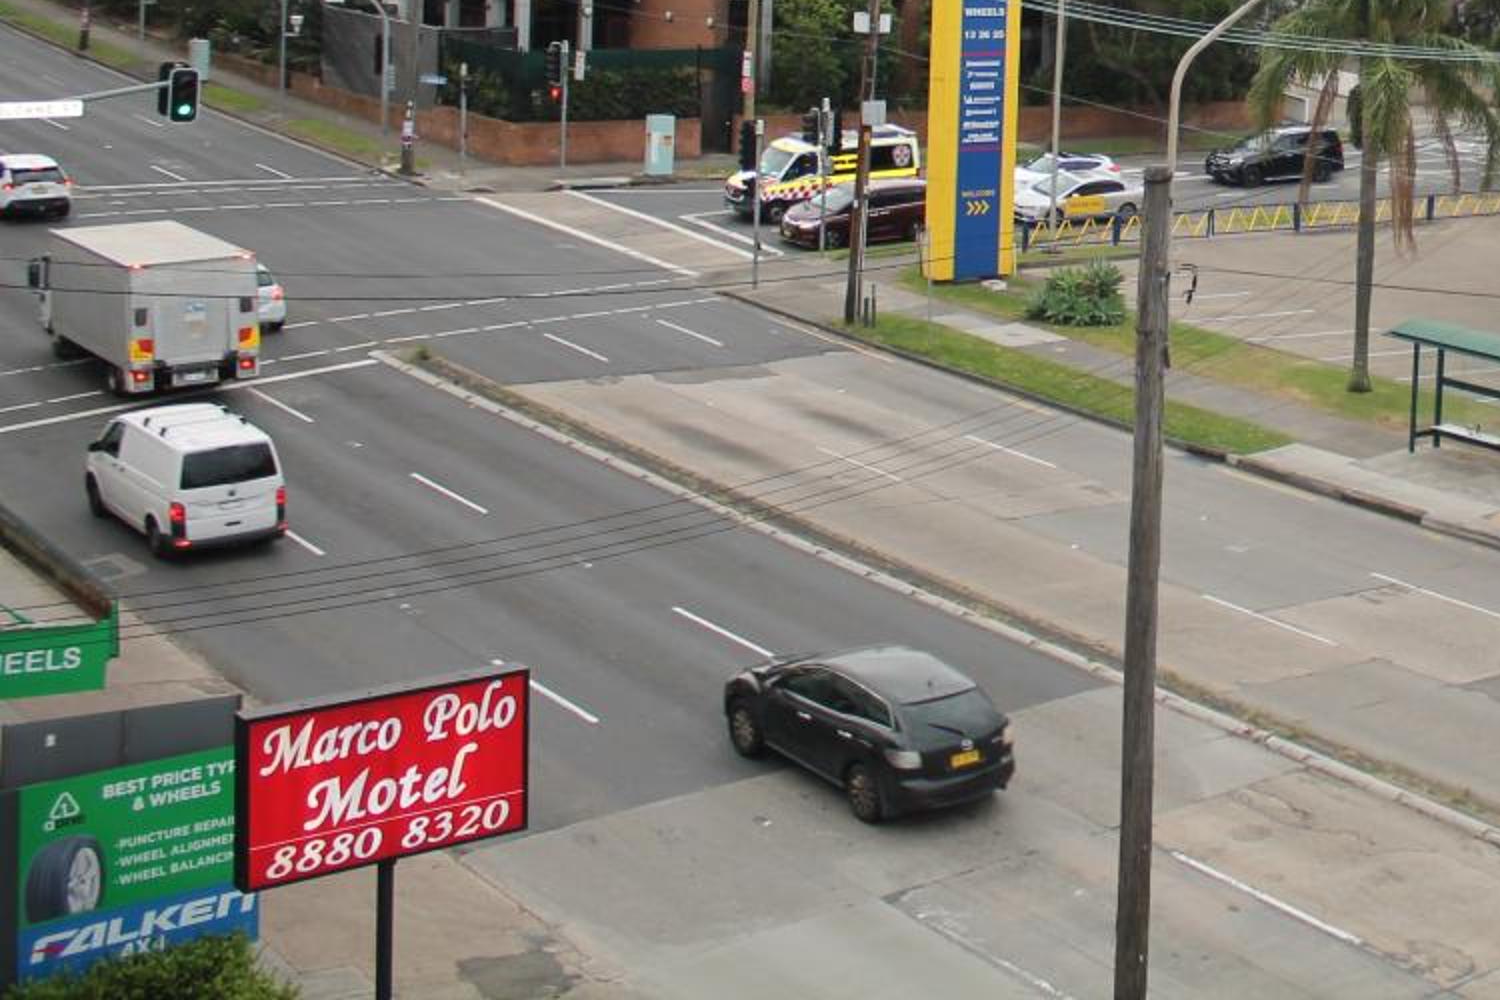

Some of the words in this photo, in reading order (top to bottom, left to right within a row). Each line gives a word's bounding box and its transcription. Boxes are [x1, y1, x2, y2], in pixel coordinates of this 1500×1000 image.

[964, 7, 1005, 17] WHEELS
[0, 646, 81, 676] EELS
[260, 718, 402, 777] Marco
[423, 680, 517, 742] Polo
[101, 777, 147, 800] BEST
[151, 767, 202, 788] PRICE
[149, 780, 221, 807] WHEELS
[303, 743, 479, 831] Motel
[193, 815, 235, 833] REPAI
[266, 827, 383, 880] 8880
[401, 799, 509, 849] 8320
